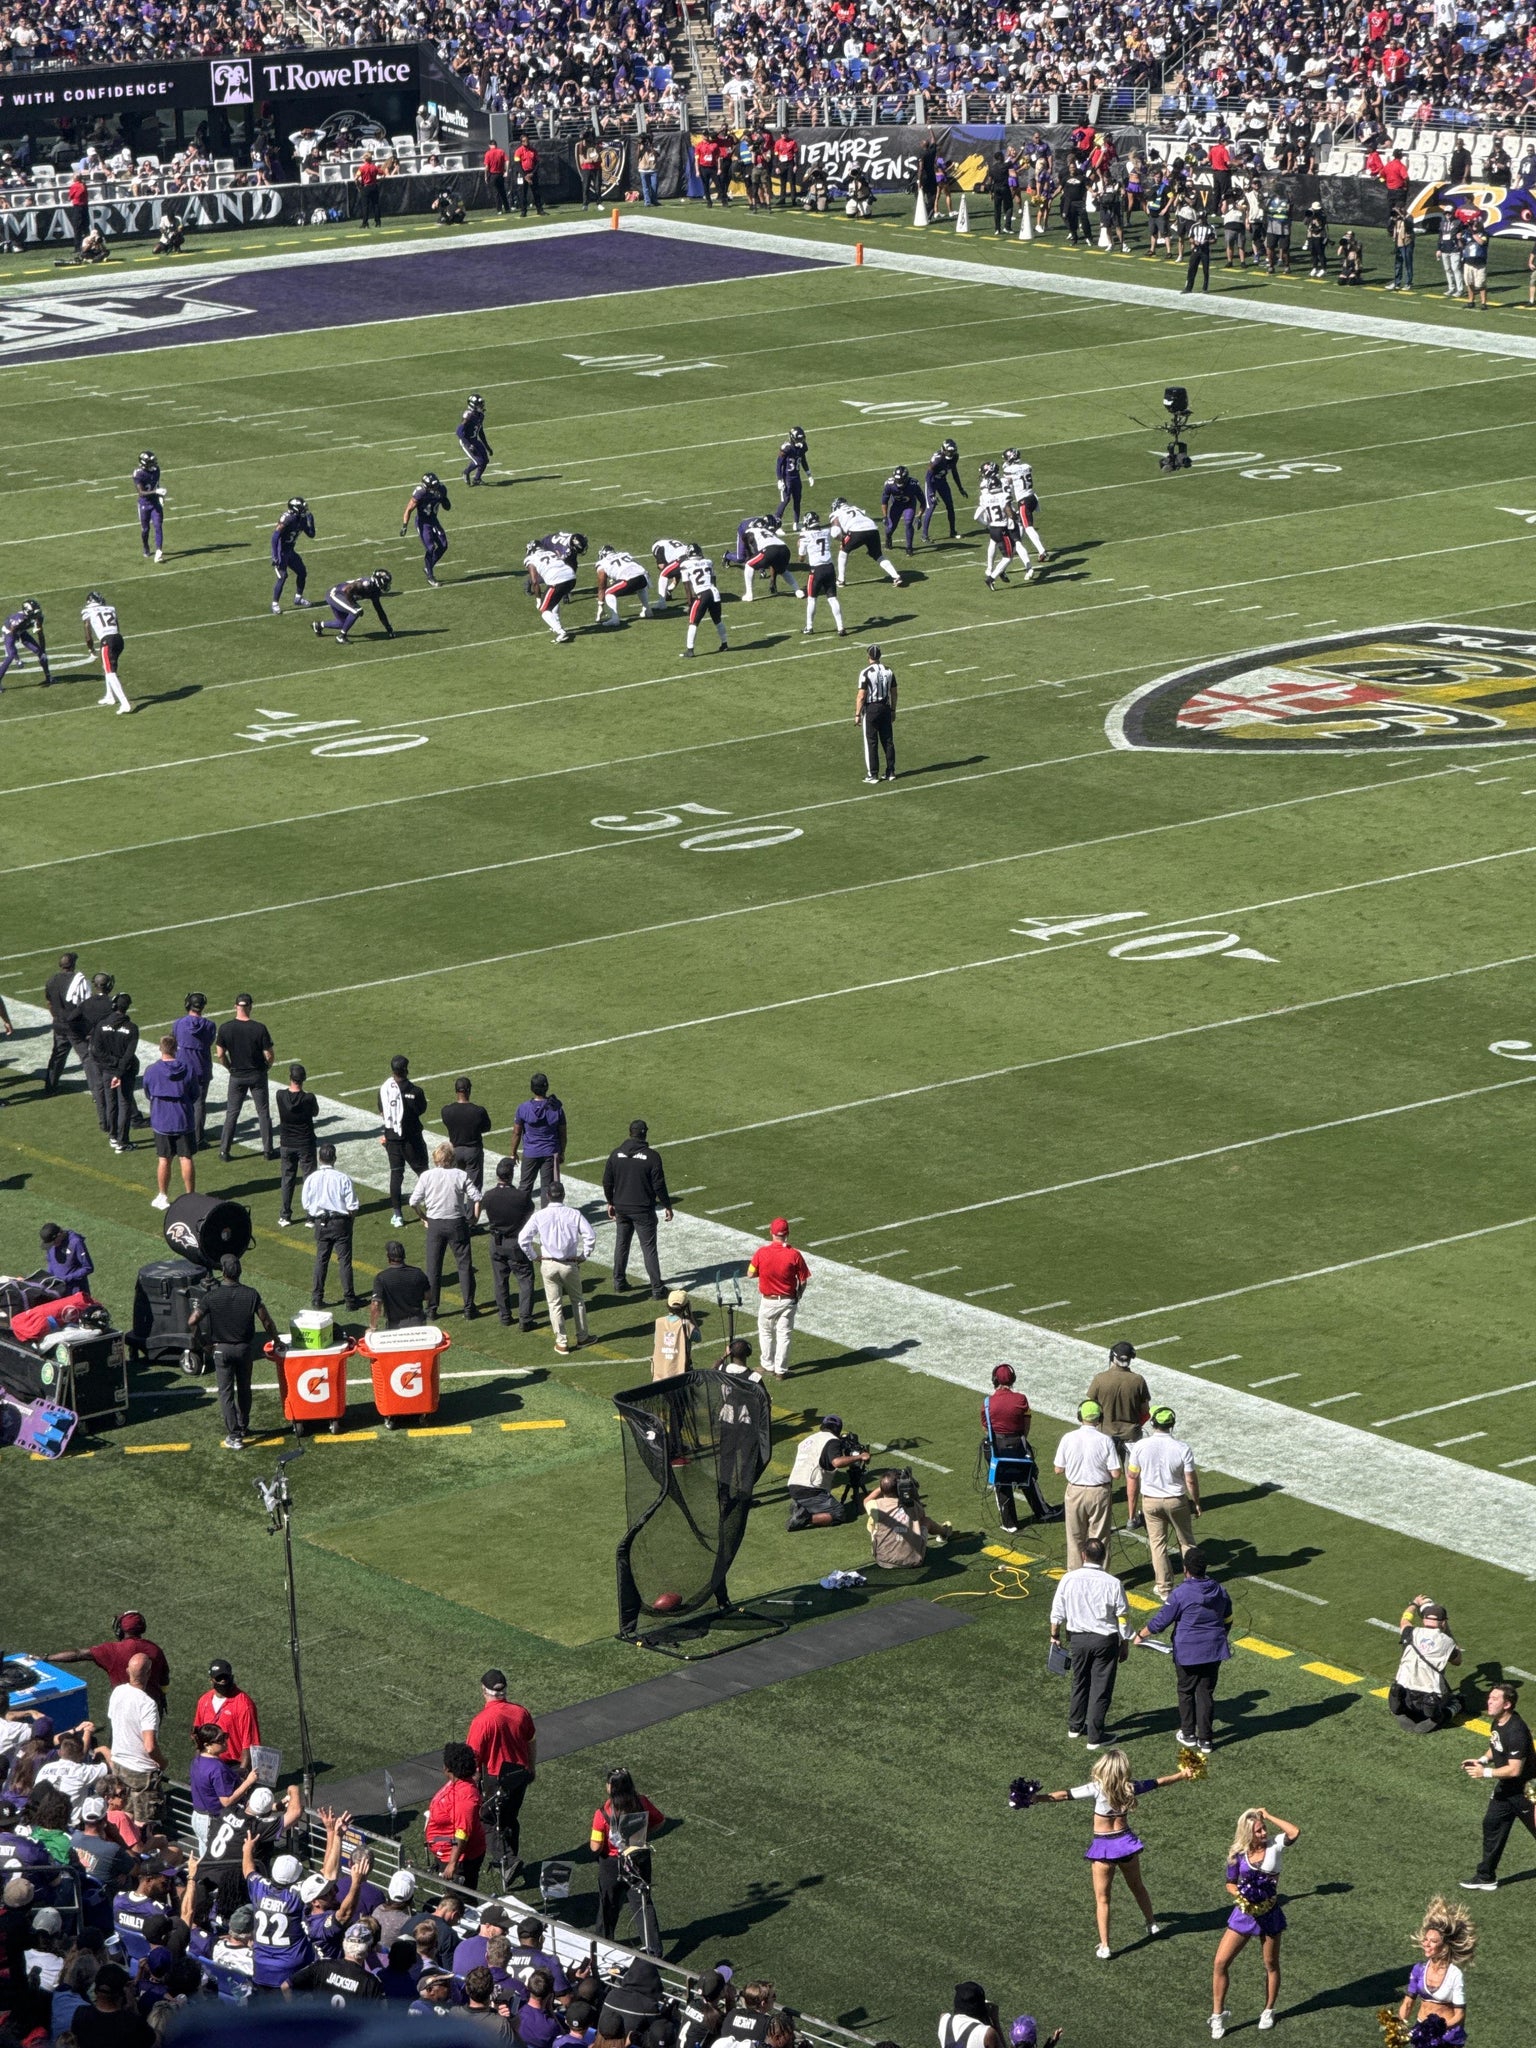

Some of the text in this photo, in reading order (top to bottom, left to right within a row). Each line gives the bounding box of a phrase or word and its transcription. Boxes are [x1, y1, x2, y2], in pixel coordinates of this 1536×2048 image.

[13, 92, 55, 106] WITH
[984, 505, 1004, 523] 13
[816, 537, 827, 557] 7
[97, 611, 116, 628] 12
[233, 719, 429, 757] 40
[590, 802, 804, 852] 50
[1008, 911, 1241, 961] 40
[297, 1367, 330, 1403] G
[390, 1362, 423, 1398] G
[210, 1823, 235, 1858] 8
[260, 1896, 287, 1913] HENRY
[118, 1912, 145, 1930] STANLEY
[255, 1910, 291, 1946] 22
[326, 1972, 360, 1993] JACKSON
